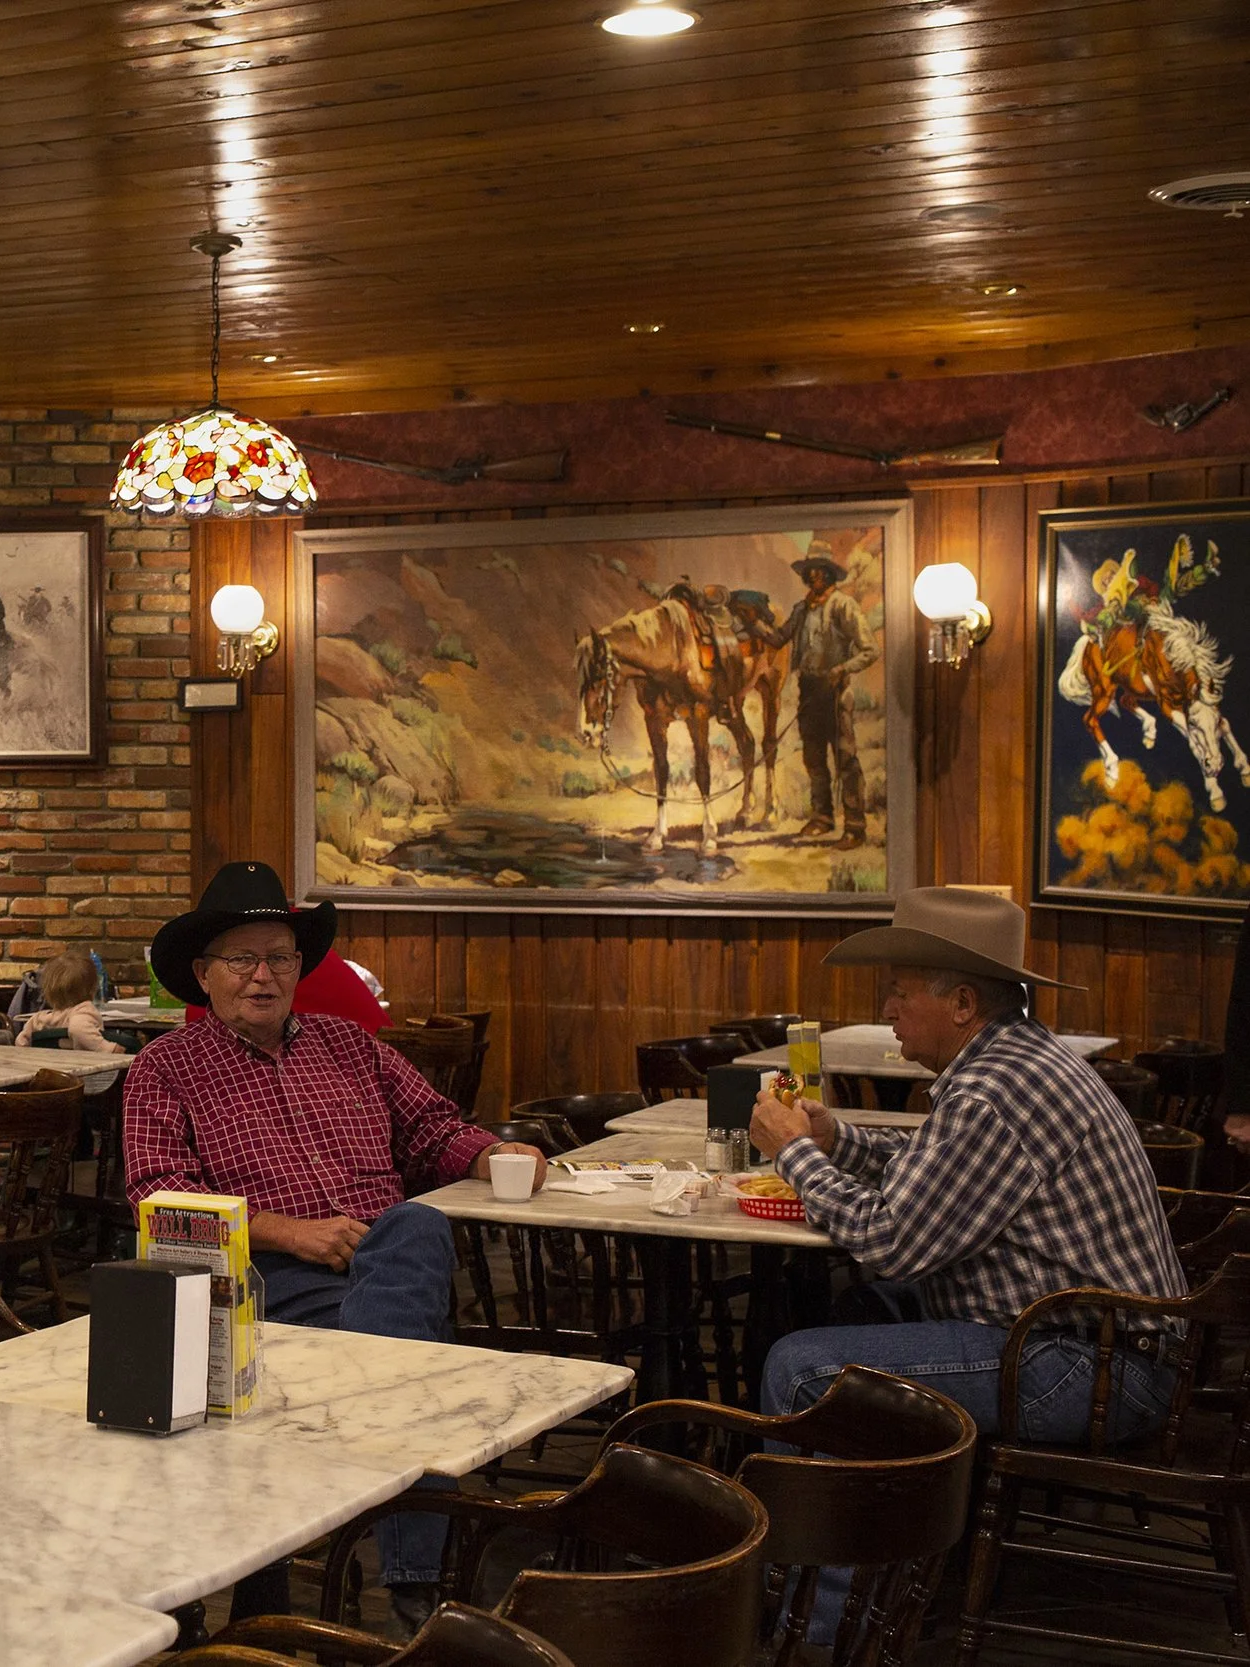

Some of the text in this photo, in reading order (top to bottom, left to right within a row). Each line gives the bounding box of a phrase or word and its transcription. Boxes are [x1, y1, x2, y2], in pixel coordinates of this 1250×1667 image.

[159, 1208, 215, 1219] Free Attractions
[146, 1214, 230, 1247] WALL DRUG
